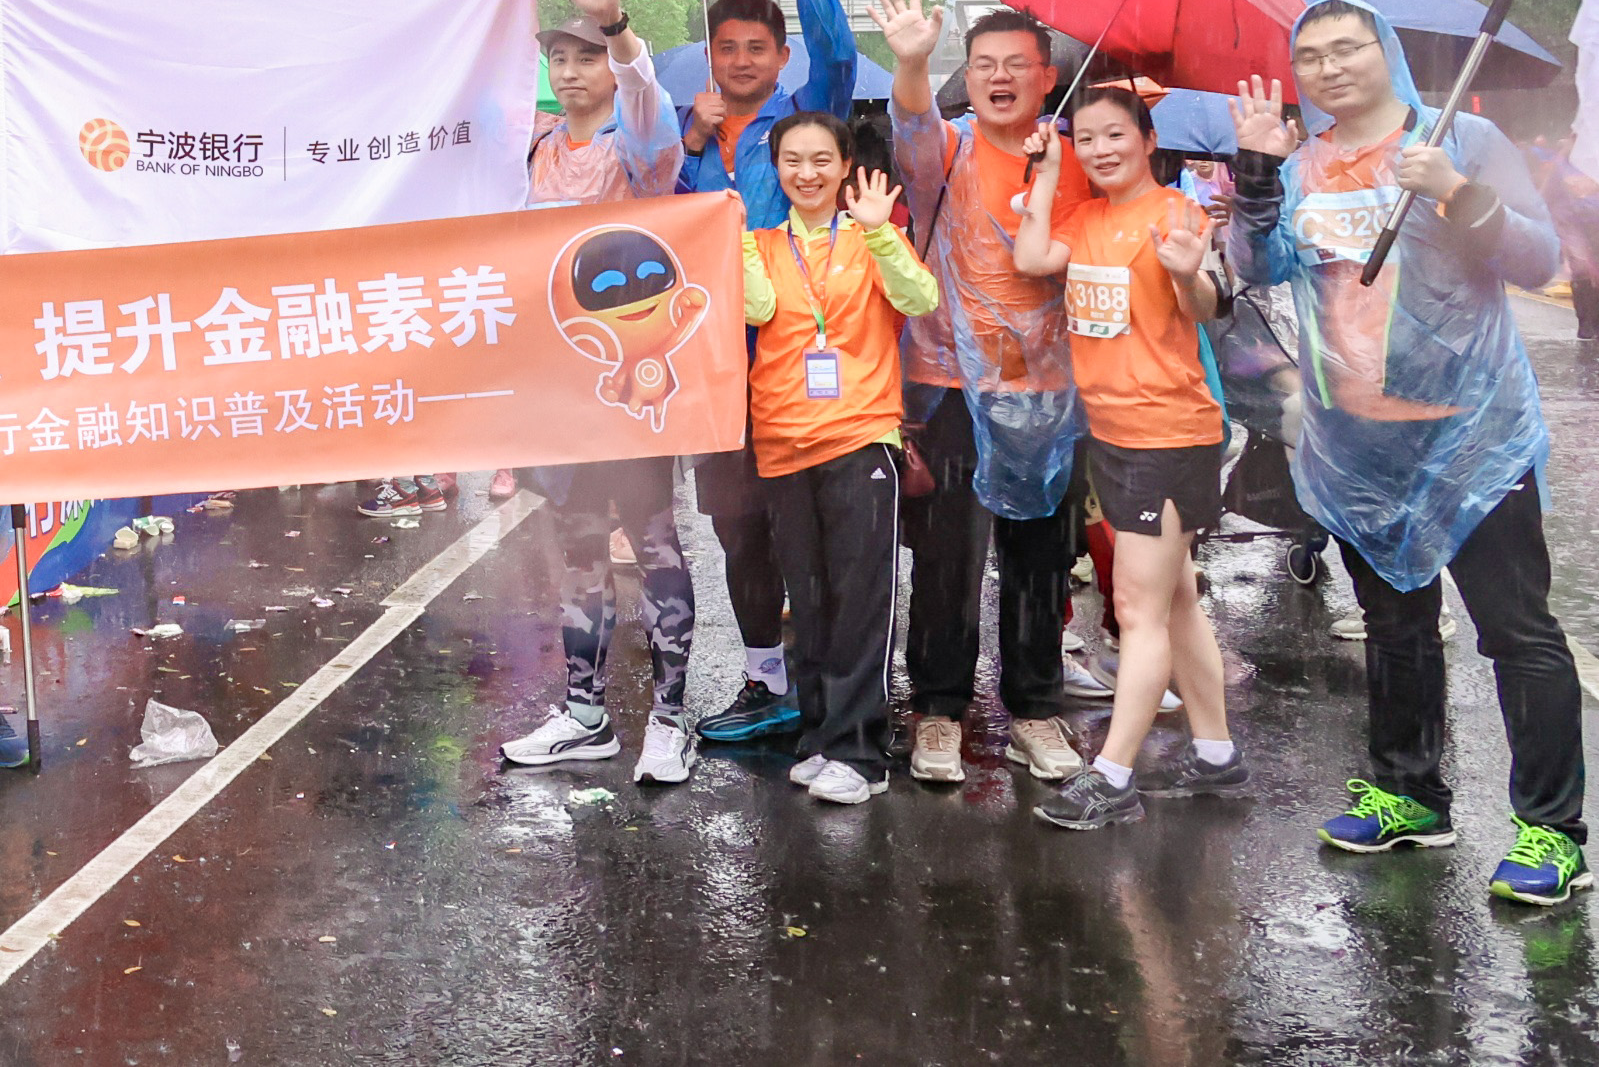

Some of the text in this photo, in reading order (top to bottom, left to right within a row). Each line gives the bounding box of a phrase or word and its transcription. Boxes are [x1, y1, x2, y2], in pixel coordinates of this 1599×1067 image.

[136, 129, 264, 164] 宁波银行
[306, 120, 472, 165] 专业创造价值
[136, 161, 264, 178] BANK OF NINGBO
[1296, 211, 1325, 245] C
[1076, 283, 1128, 311] 3188
[33, 265, 518, 380] 提升金融素养
